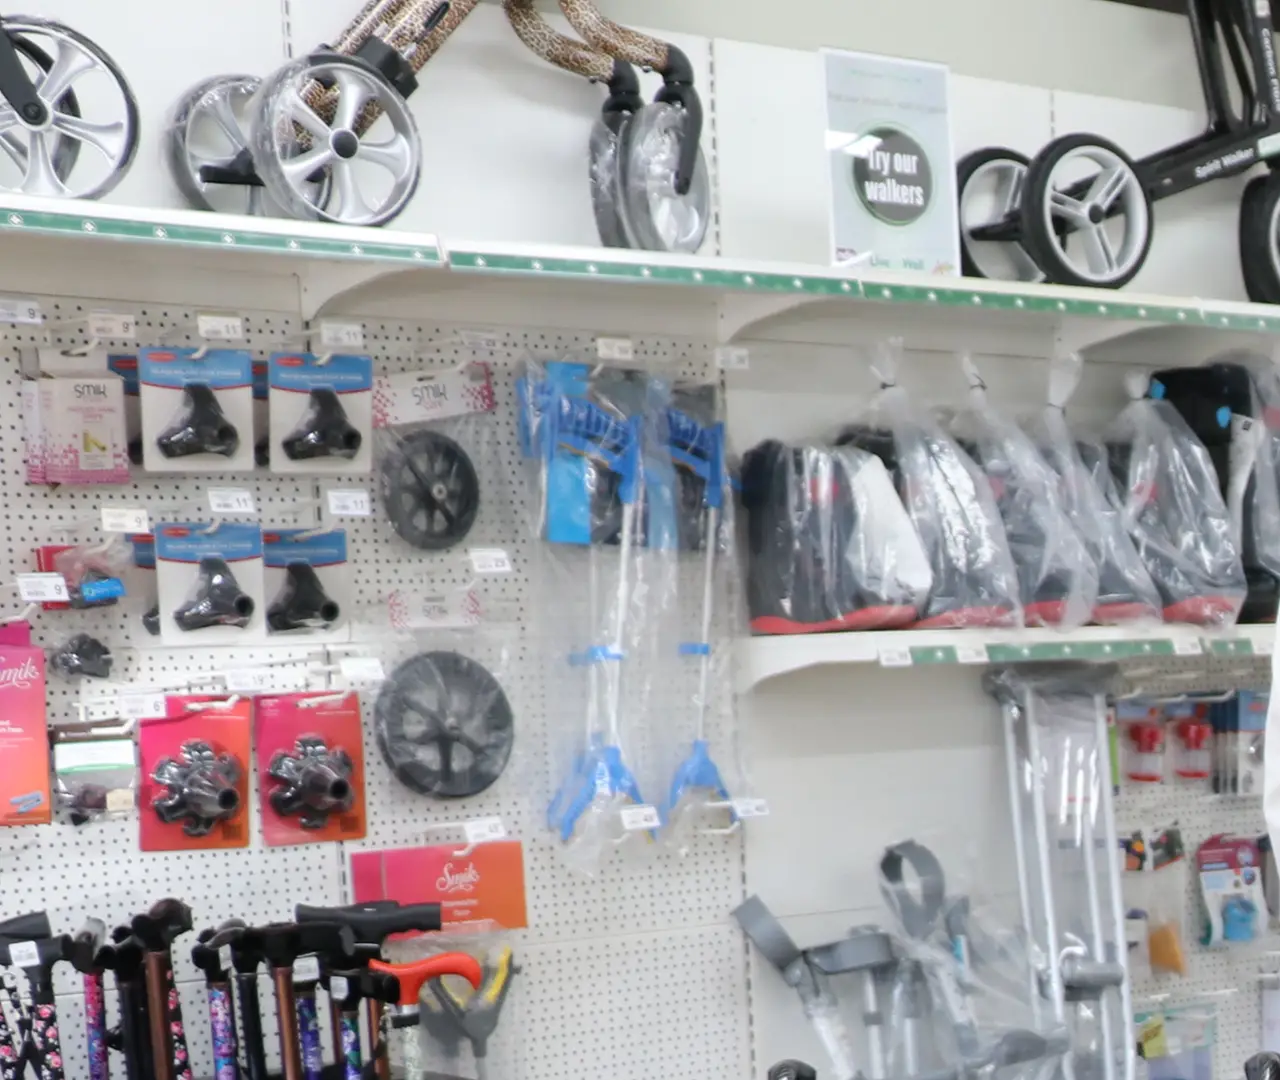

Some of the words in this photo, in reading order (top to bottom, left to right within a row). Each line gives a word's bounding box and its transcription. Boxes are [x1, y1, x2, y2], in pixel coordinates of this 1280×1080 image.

[866, 147, 891, 176] Try
[893, 153, 919, 176] our
[864, 178, 925, 206] walkers
[0, 656, 40, 688] mik
